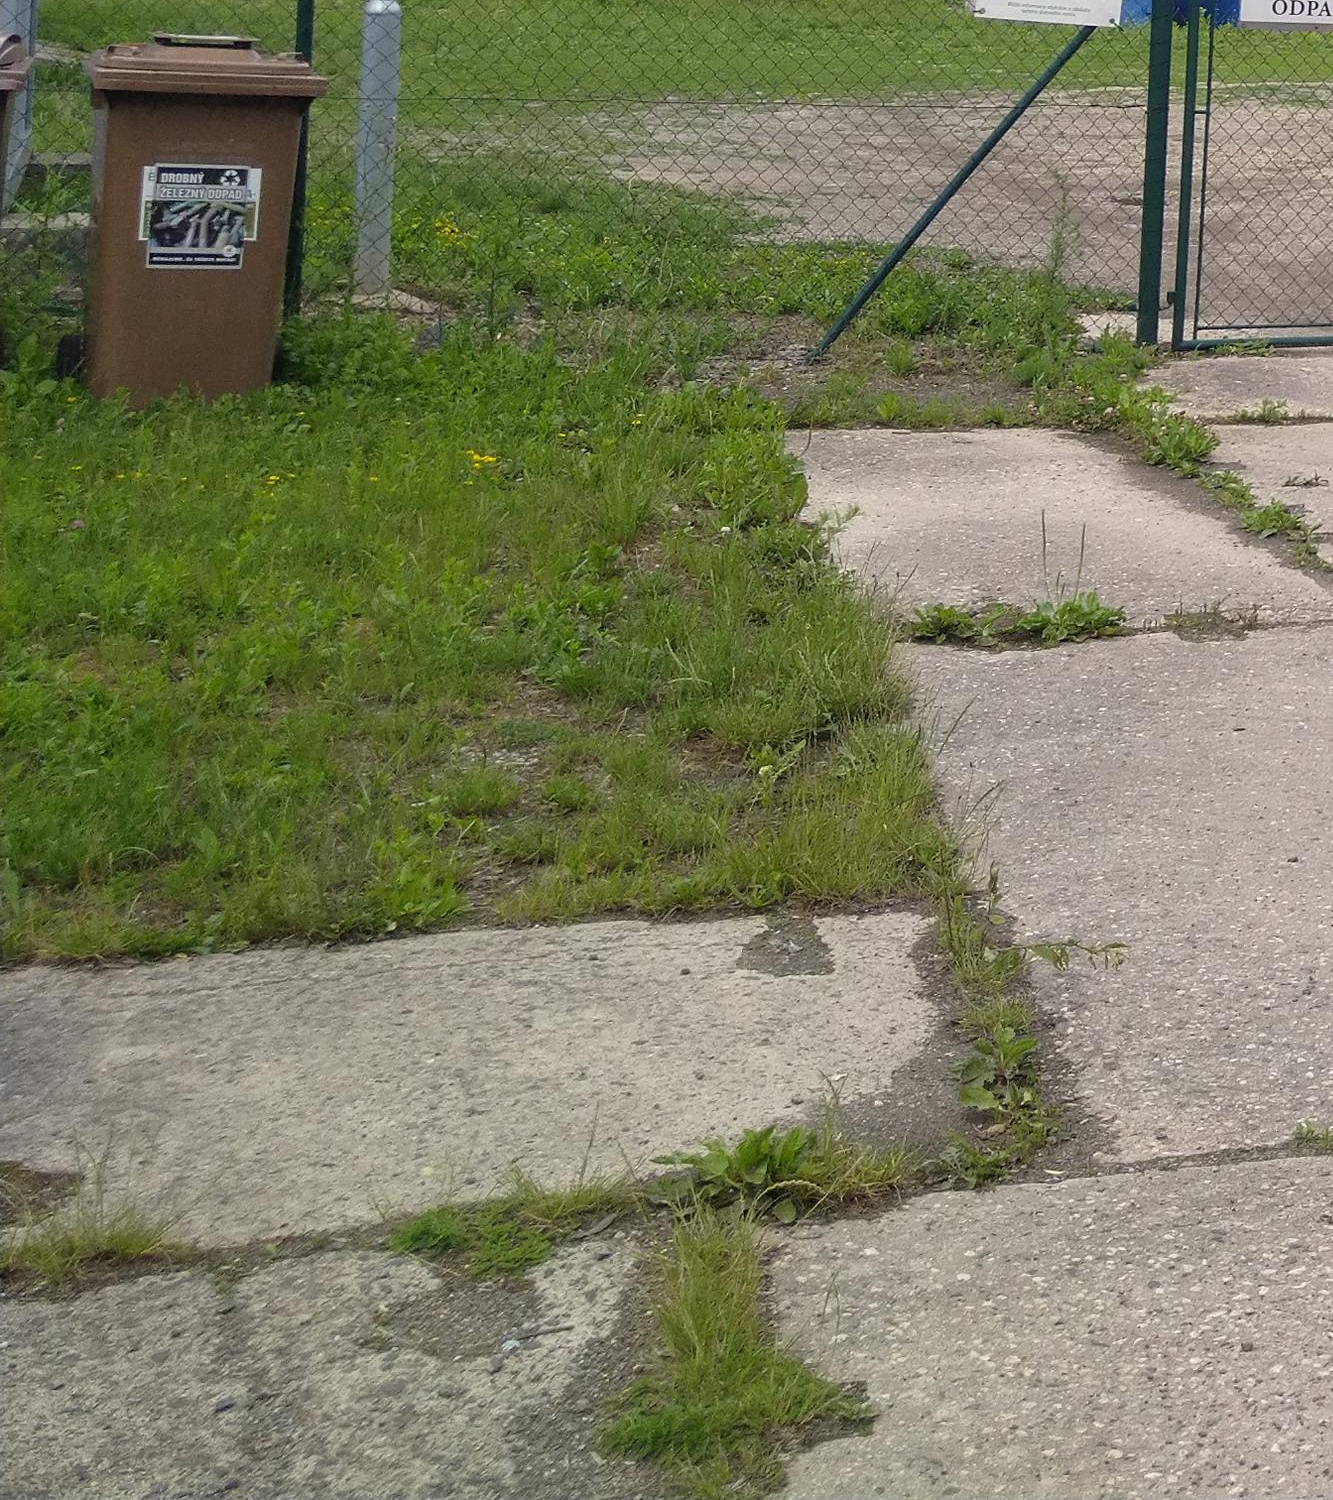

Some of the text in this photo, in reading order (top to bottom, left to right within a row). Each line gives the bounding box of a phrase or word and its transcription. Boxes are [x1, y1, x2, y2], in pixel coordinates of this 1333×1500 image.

[161, 171, 205, 184] DROBNÝ
[160, 186, 242, 200] ŽELEZNÝ ODPAD
